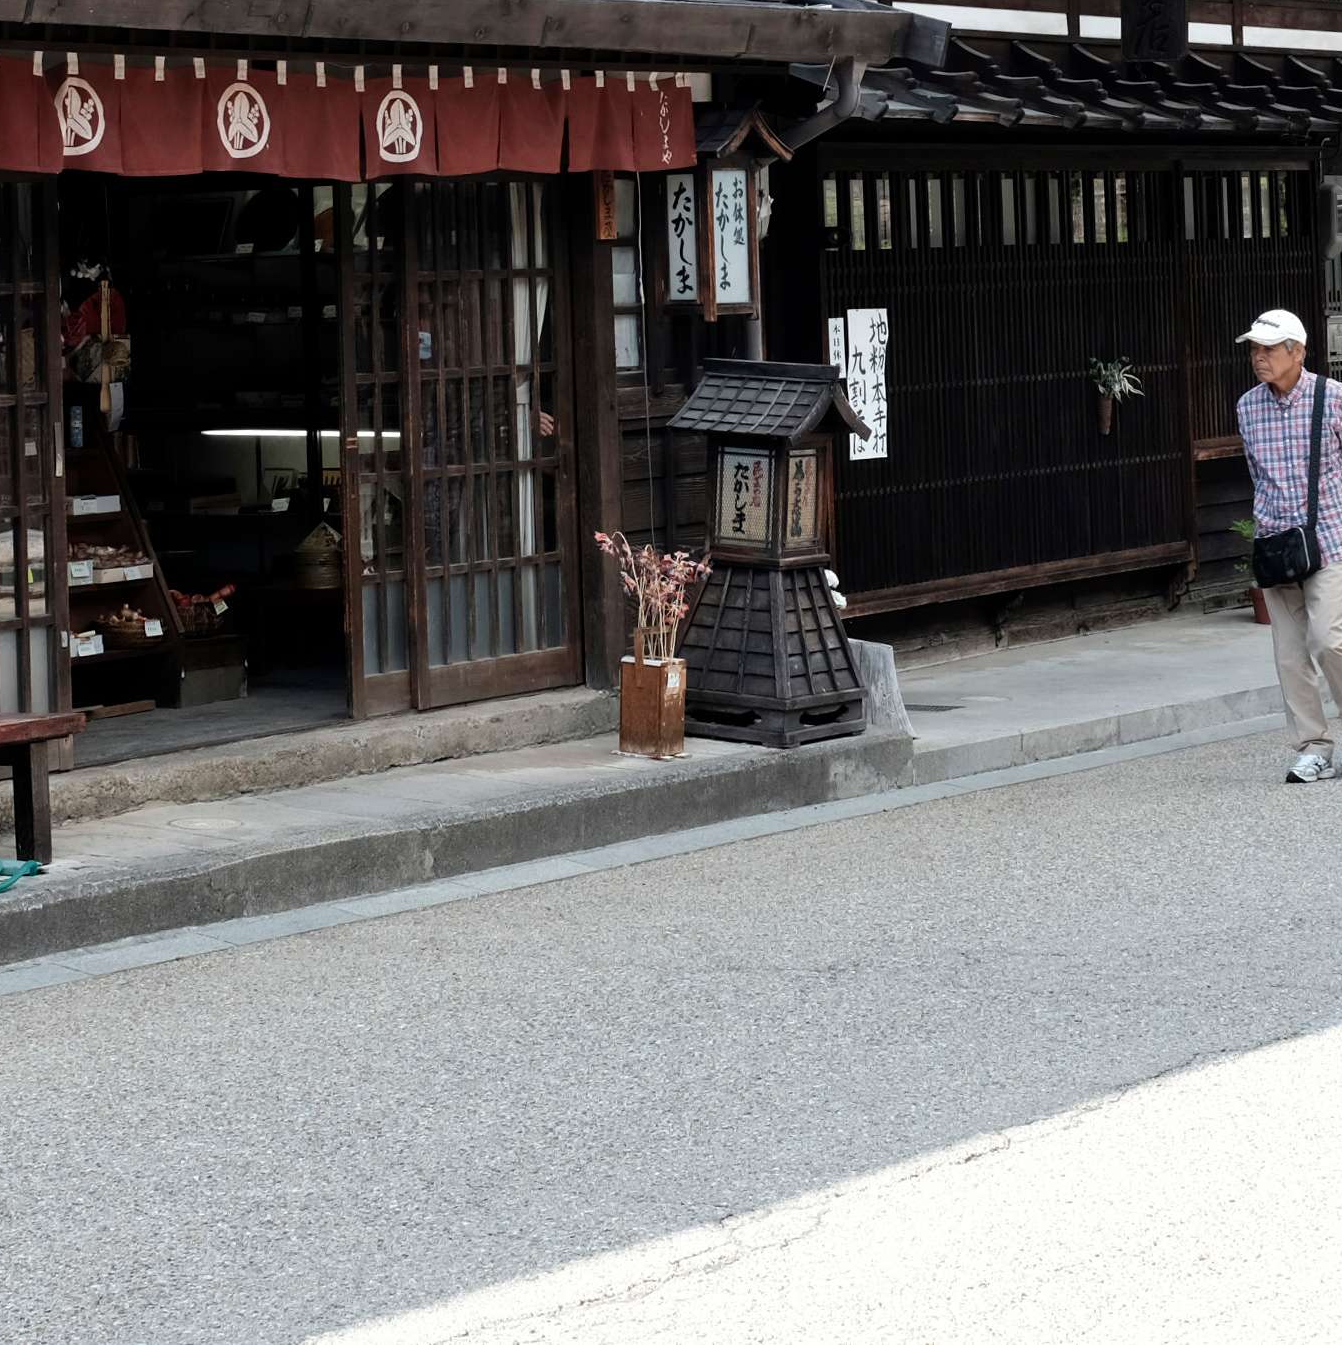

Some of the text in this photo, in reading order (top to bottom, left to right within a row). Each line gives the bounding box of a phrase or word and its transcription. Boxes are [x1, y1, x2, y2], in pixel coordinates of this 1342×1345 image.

[670, 181, 693, 294] たかしま
[713, 181, 731, 291] たかしま
[731, 175, 746, 247] お休処
[832, 323, 842, 367] 本日休
[869, 311, 887, 454] 地粉本手打
[731, 461, 749, 535] たかしま
